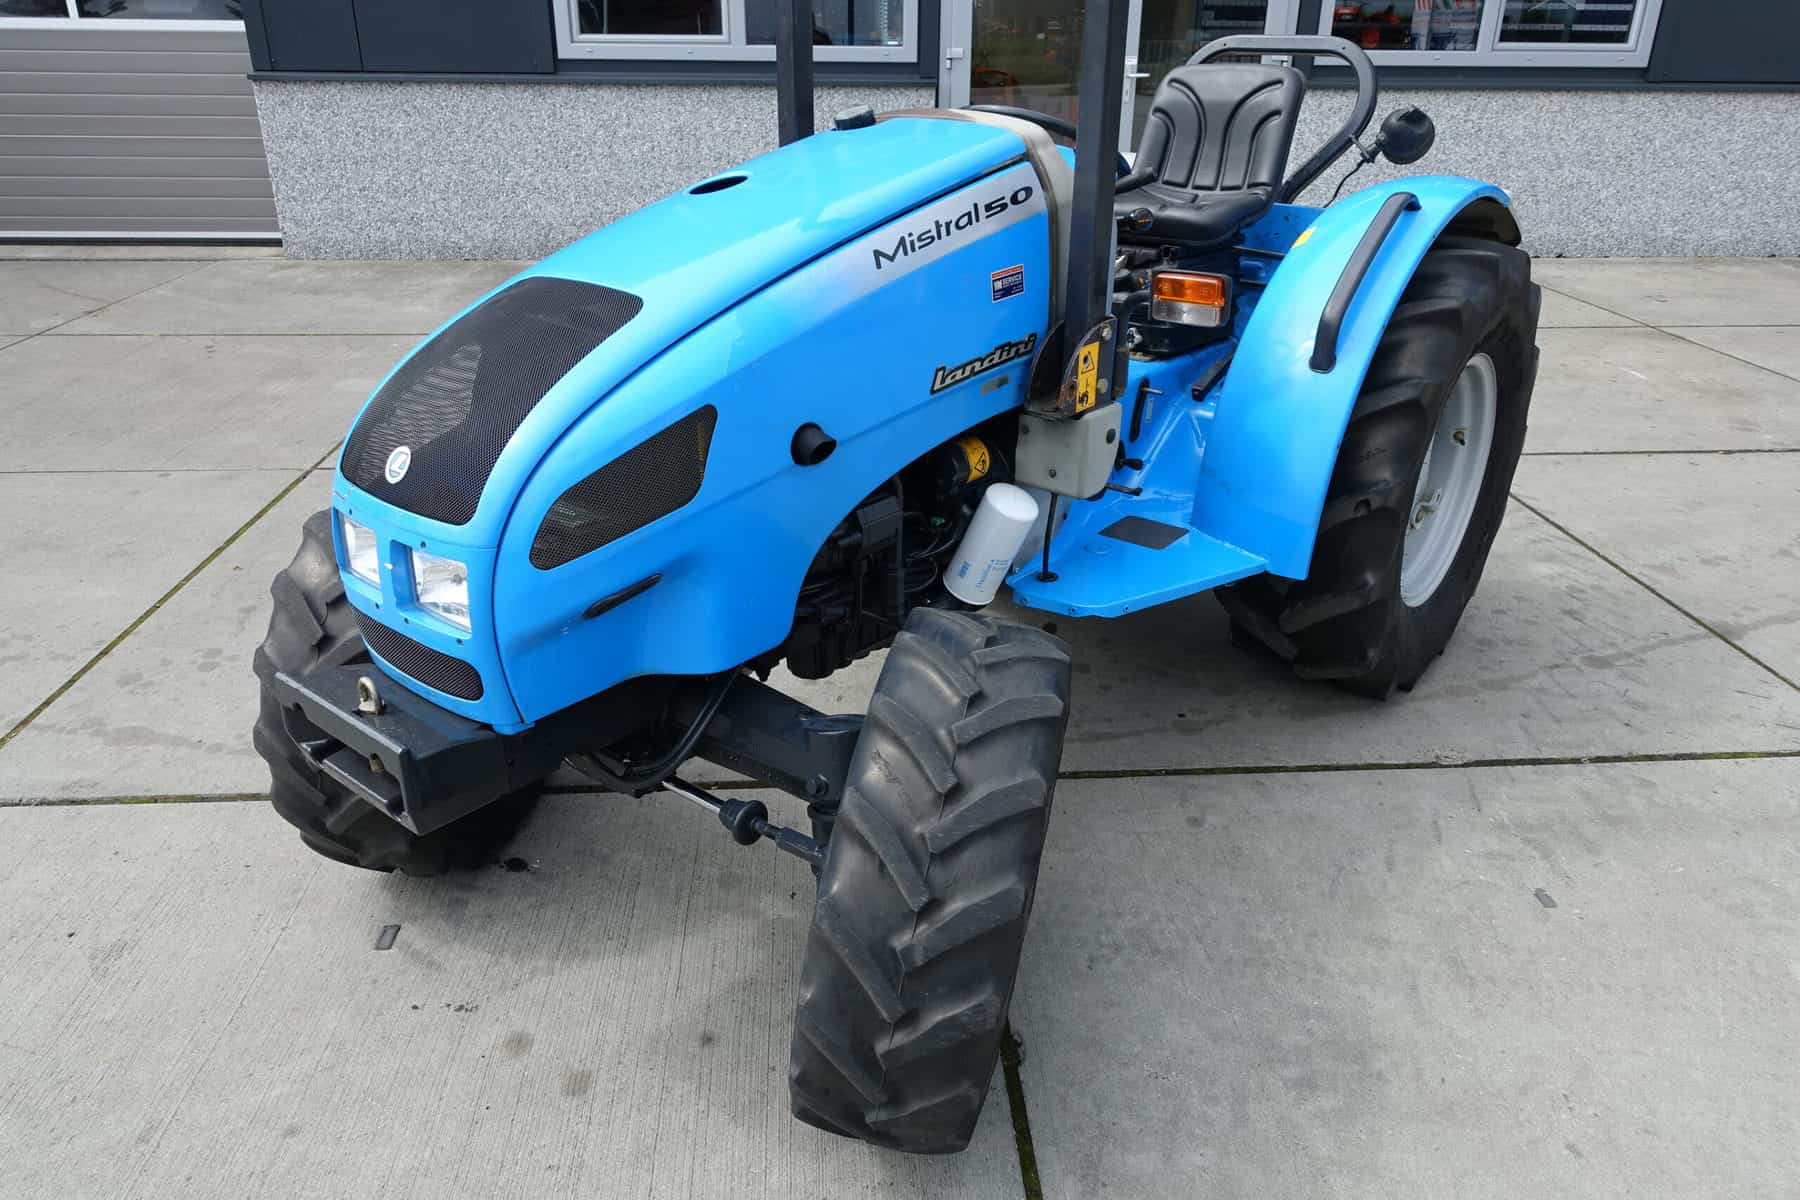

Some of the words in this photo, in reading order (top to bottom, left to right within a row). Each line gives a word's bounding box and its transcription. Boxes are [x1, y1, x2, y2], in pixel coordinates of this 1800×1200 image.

[872, 202, 980, 270] Mistral
[984, 185, 1034, 219] 50
[930, 332, 1037, 395] Landini
